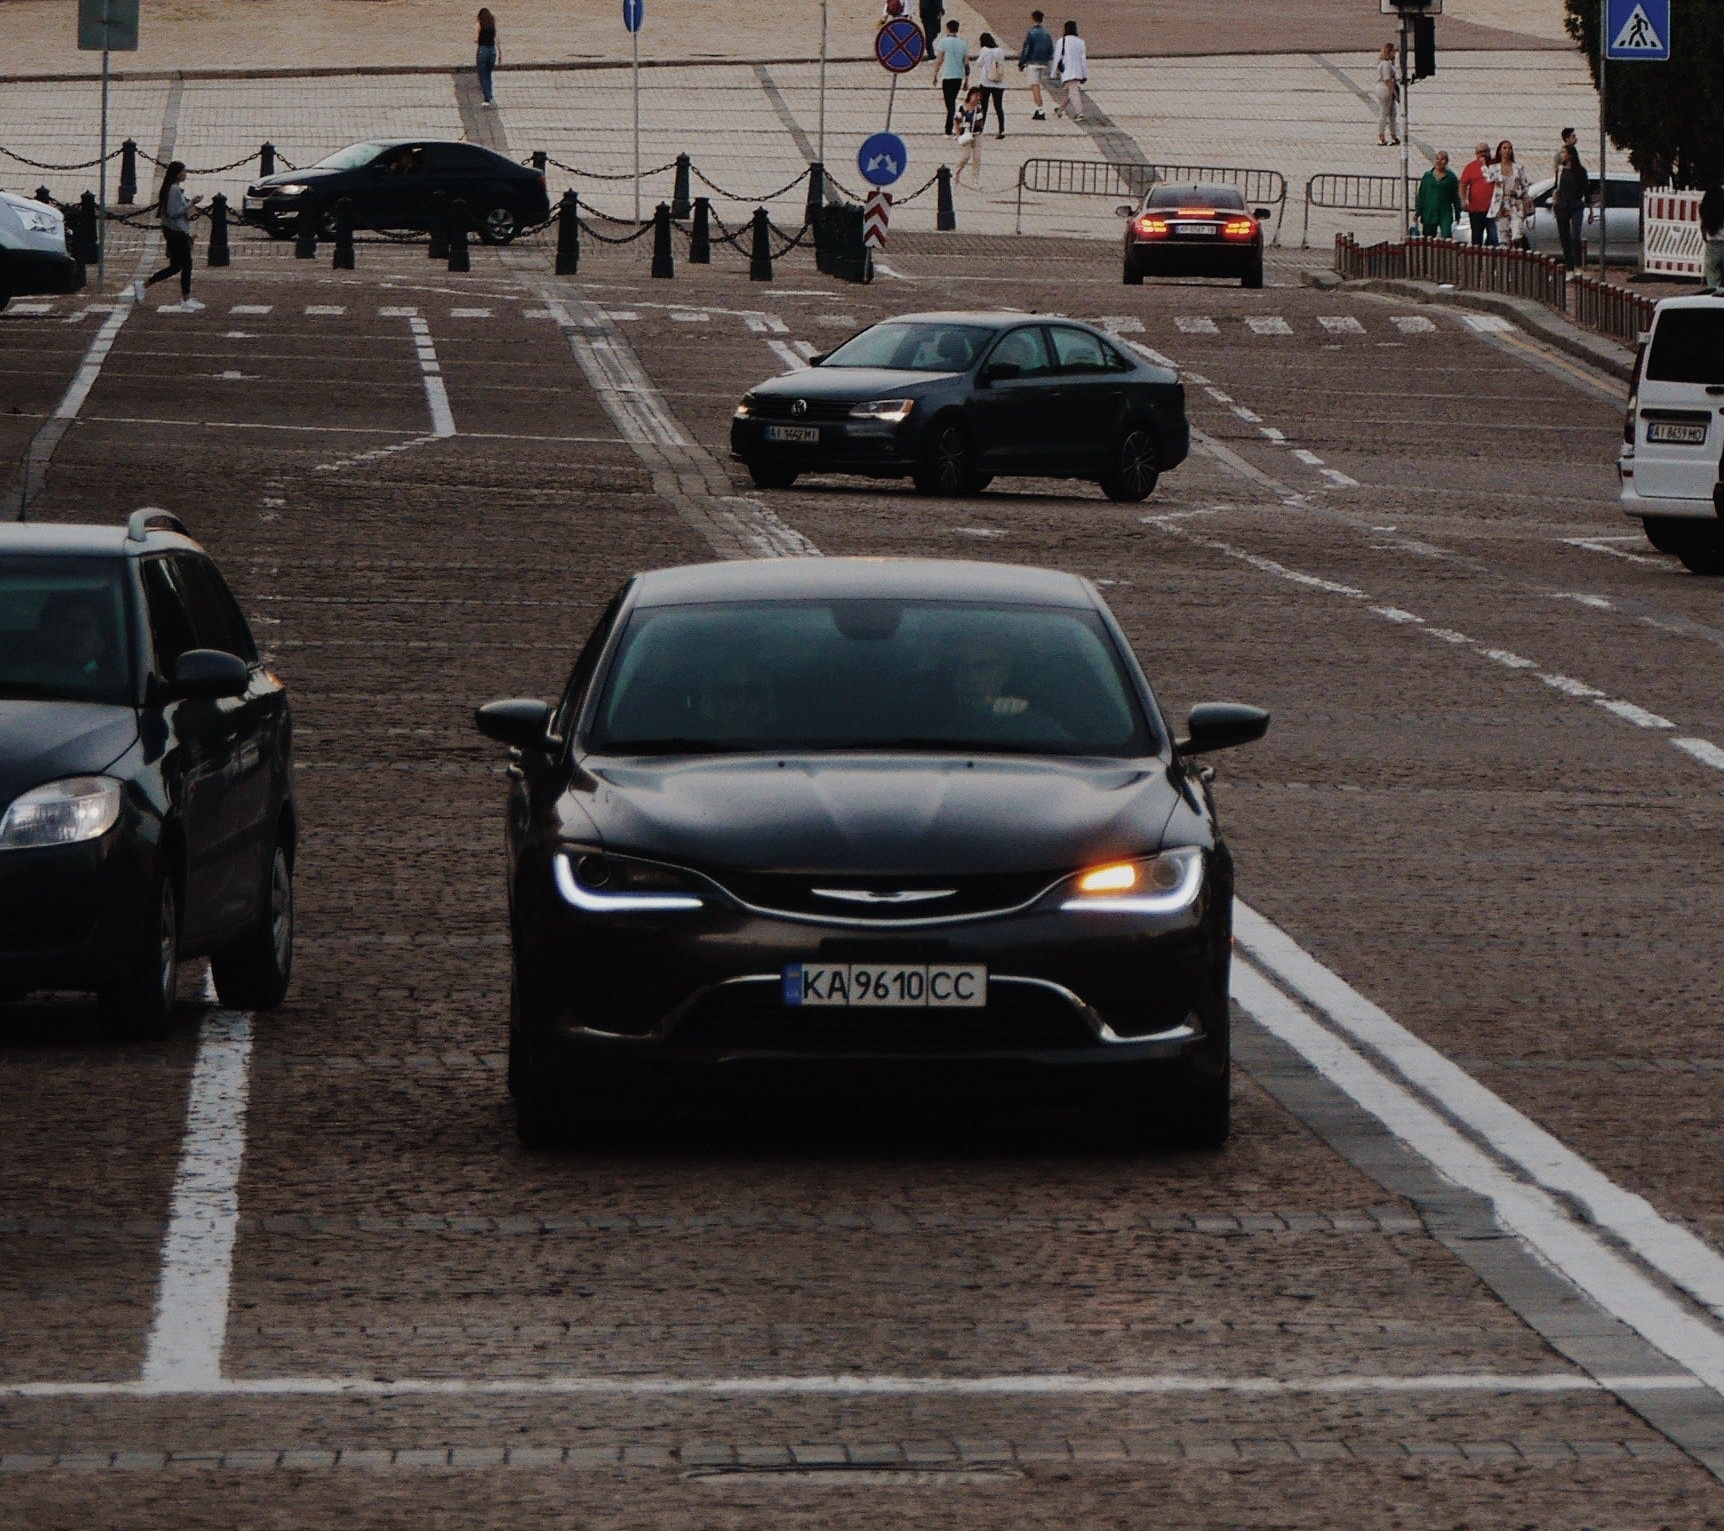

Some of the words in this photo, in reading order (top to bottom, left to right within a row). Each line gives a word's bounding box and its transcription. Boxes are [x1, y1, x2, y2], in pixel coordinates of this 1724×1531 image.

[804, 970, 848, 1000] KA
[855, 971, 924, 1000] 9610
[931, 971, 975, 1000] CC
